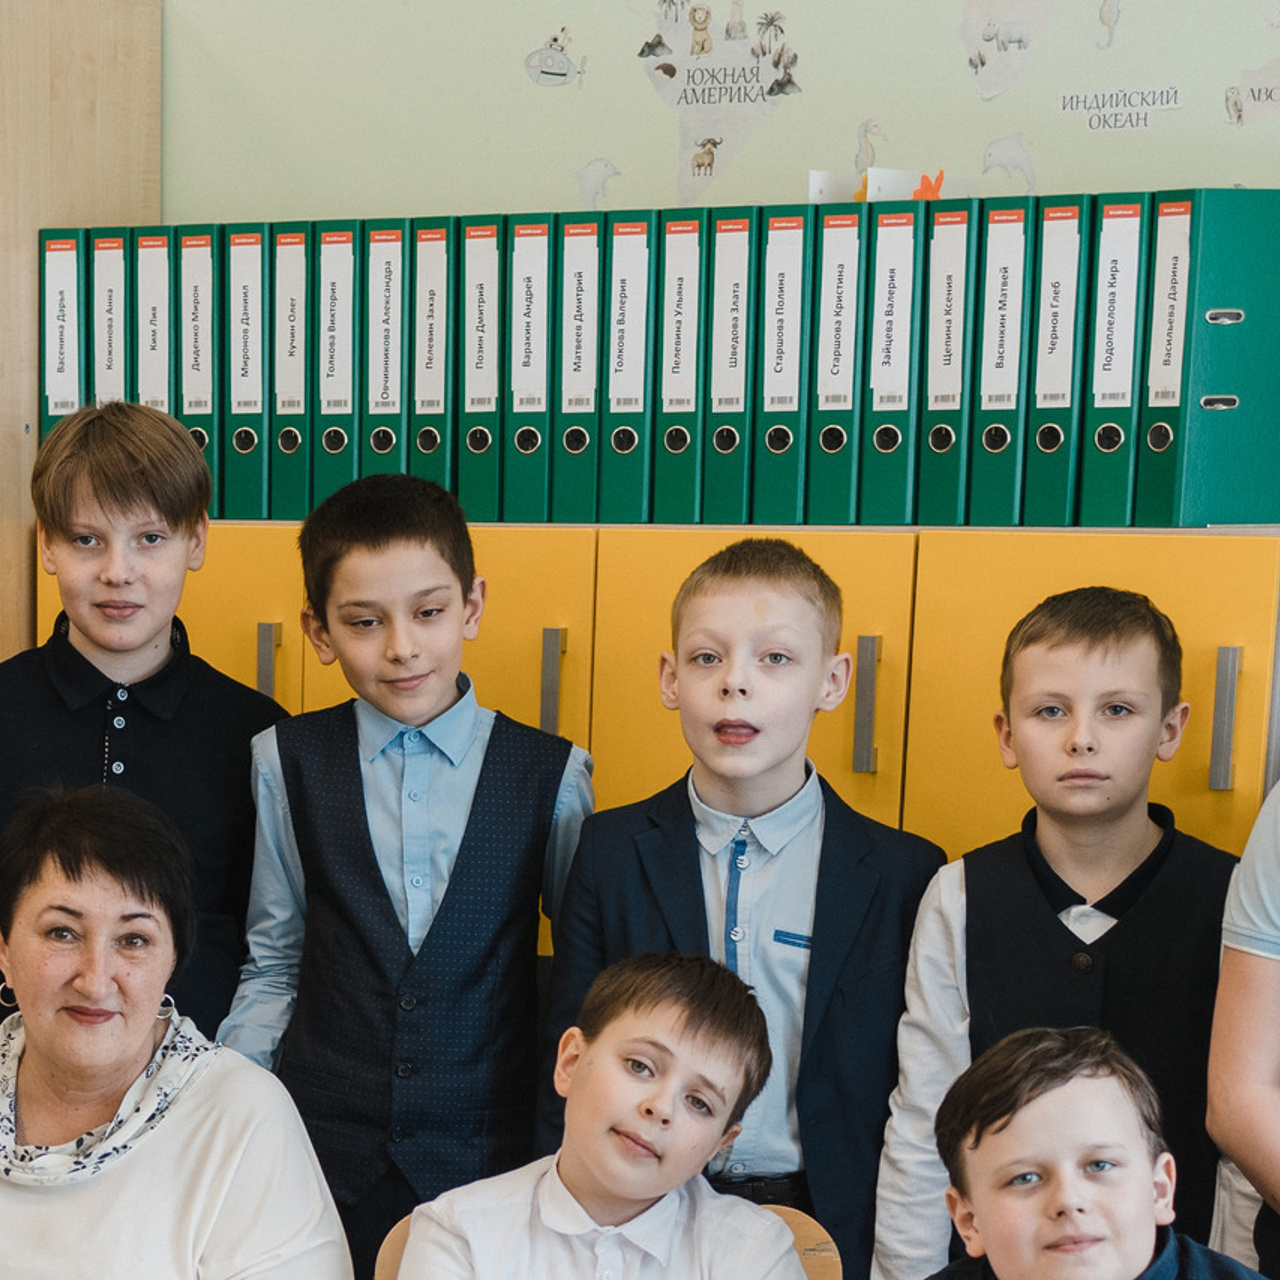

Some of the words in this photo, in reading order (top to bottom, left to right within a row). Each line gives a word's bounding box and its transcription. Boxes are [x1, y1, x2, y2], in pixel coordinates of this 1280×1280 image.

[677, 85, 767, 105] АМЕРИКА
[686, 66, 761, 86] ЮЖНАЯ
[1062, 86, 1178, 113] ИНДИЙСКИЙ
[1088, 112, 1148, 130] ОКЕАН
[381, 260, 393, 326] Александра
[673, 276, 685, 317] Ульяна
[774, 272, 786, 316] Полина
[833, 263, 845, 318] Кристина
[884, 268, 898, 317] Валерия
[943, 274, 953, 316] Ксения
[997, 266, 1009, 311] Матвей
[1049, 280, 1061, 309] Глеб
[1107, 259, 1120, 289] Кира
[1167, 255, 1179, 302] Дарина
[56, 289, 67, 323] Дарья
[105, 288, 114, 315] Анна
[191, 285, 201, 322] Мирон
[287, 297, 297, 323] Олег
[326, 281, 339, 333] Виктория
[425, 289, 437, 320] Захар
[475, 282, 487, 334] Дмитрий
[522, 275, 534, 319] Андрей
[573, 271, 585, 323] Дмитрий
[615, 278, 628, 326] Валерия
[729, 282, 740, 314] Злата
[56, 324, 66, 374] Васенина
[149, 328, 157, 351] Ким
[191, 324, 201, 372] Диденко
[240, 328, 251, 378] Миронов
[287, 324, 298, 357] Кучин
[326, 334, 336, 379] Толкова
[425, 322, 434, 370] Пелевин
[474, 335, 484, 370] Позин
[572, 324, 583, 373] Матвеев
[614, 328, 625, 374] Толкова
[671, 319, 683, 375] Пелевина
[773, 317, 786, 374] Старшова
[830, 319, 843, 376] Старшова
[881, 319, 895, 367] Зайцева
[1162, 304, 1176, 366] Васильева
[380, 327, 391, 401] Овчинникова
